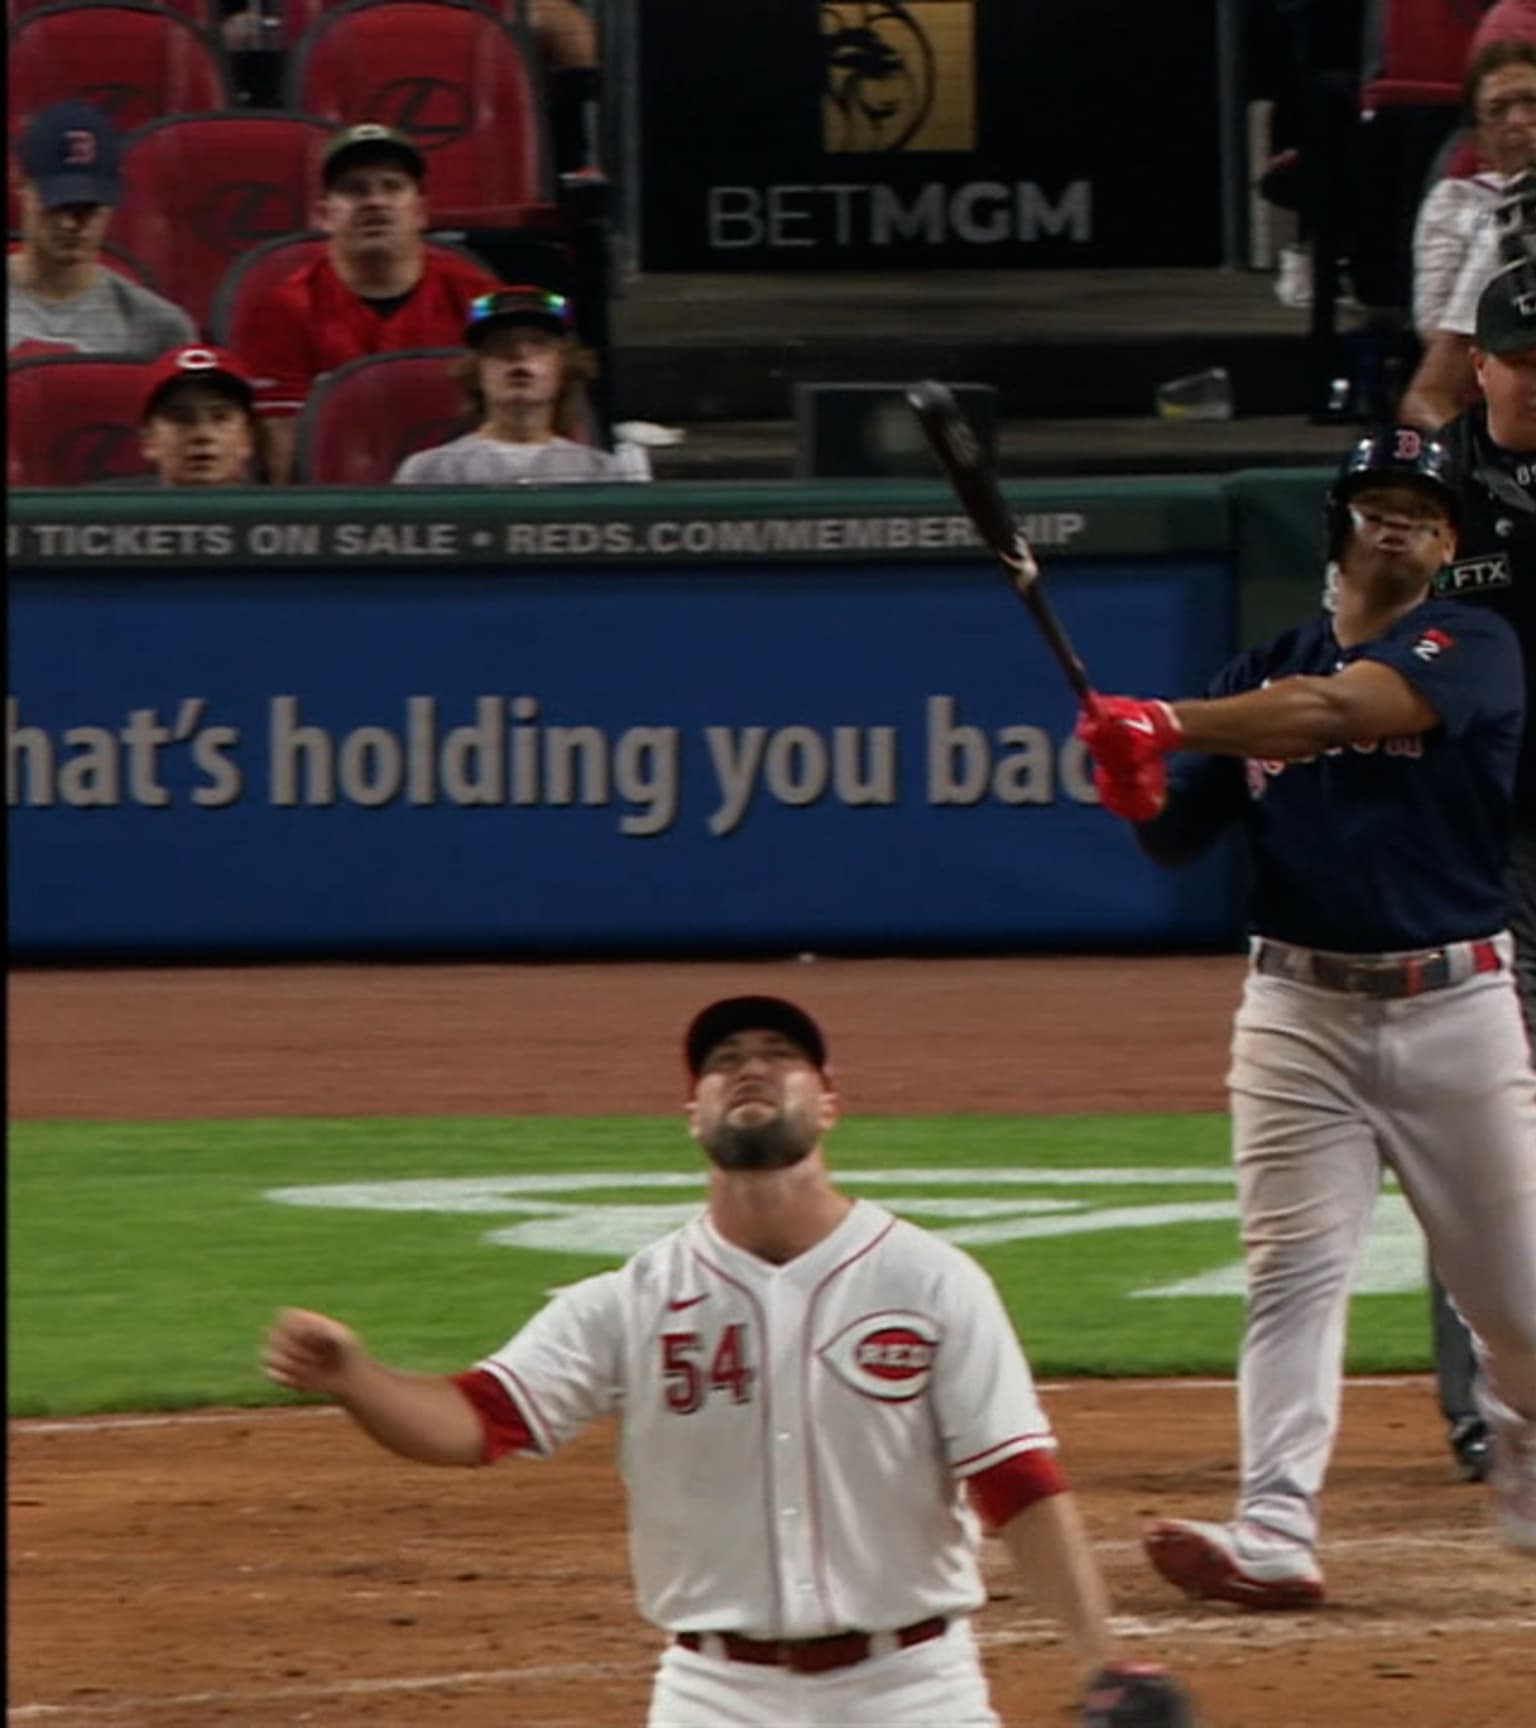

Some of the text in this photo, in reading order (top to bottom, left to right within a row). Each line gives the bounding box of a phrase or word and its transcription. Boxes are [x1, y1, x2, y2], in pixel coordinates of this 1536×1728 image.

[707, 179, 1092, 247] BETMGM
[1392, 429, 1422, 462] B
[34, 524, 233, 556] TICKETS
[248, 524, 318, 556] ON
[333, 524, 458, 556] SALE
[506, 513, 1085, 554] REDS.COM/MEMBERHIP
[1453, 560, 1506, 588] FTX
[270, 695, 679, 836] holding
[704, 725, 896, 836] you
[928, 695, 1100, 806] bac
[659, 1323, 754, 1415] 54
